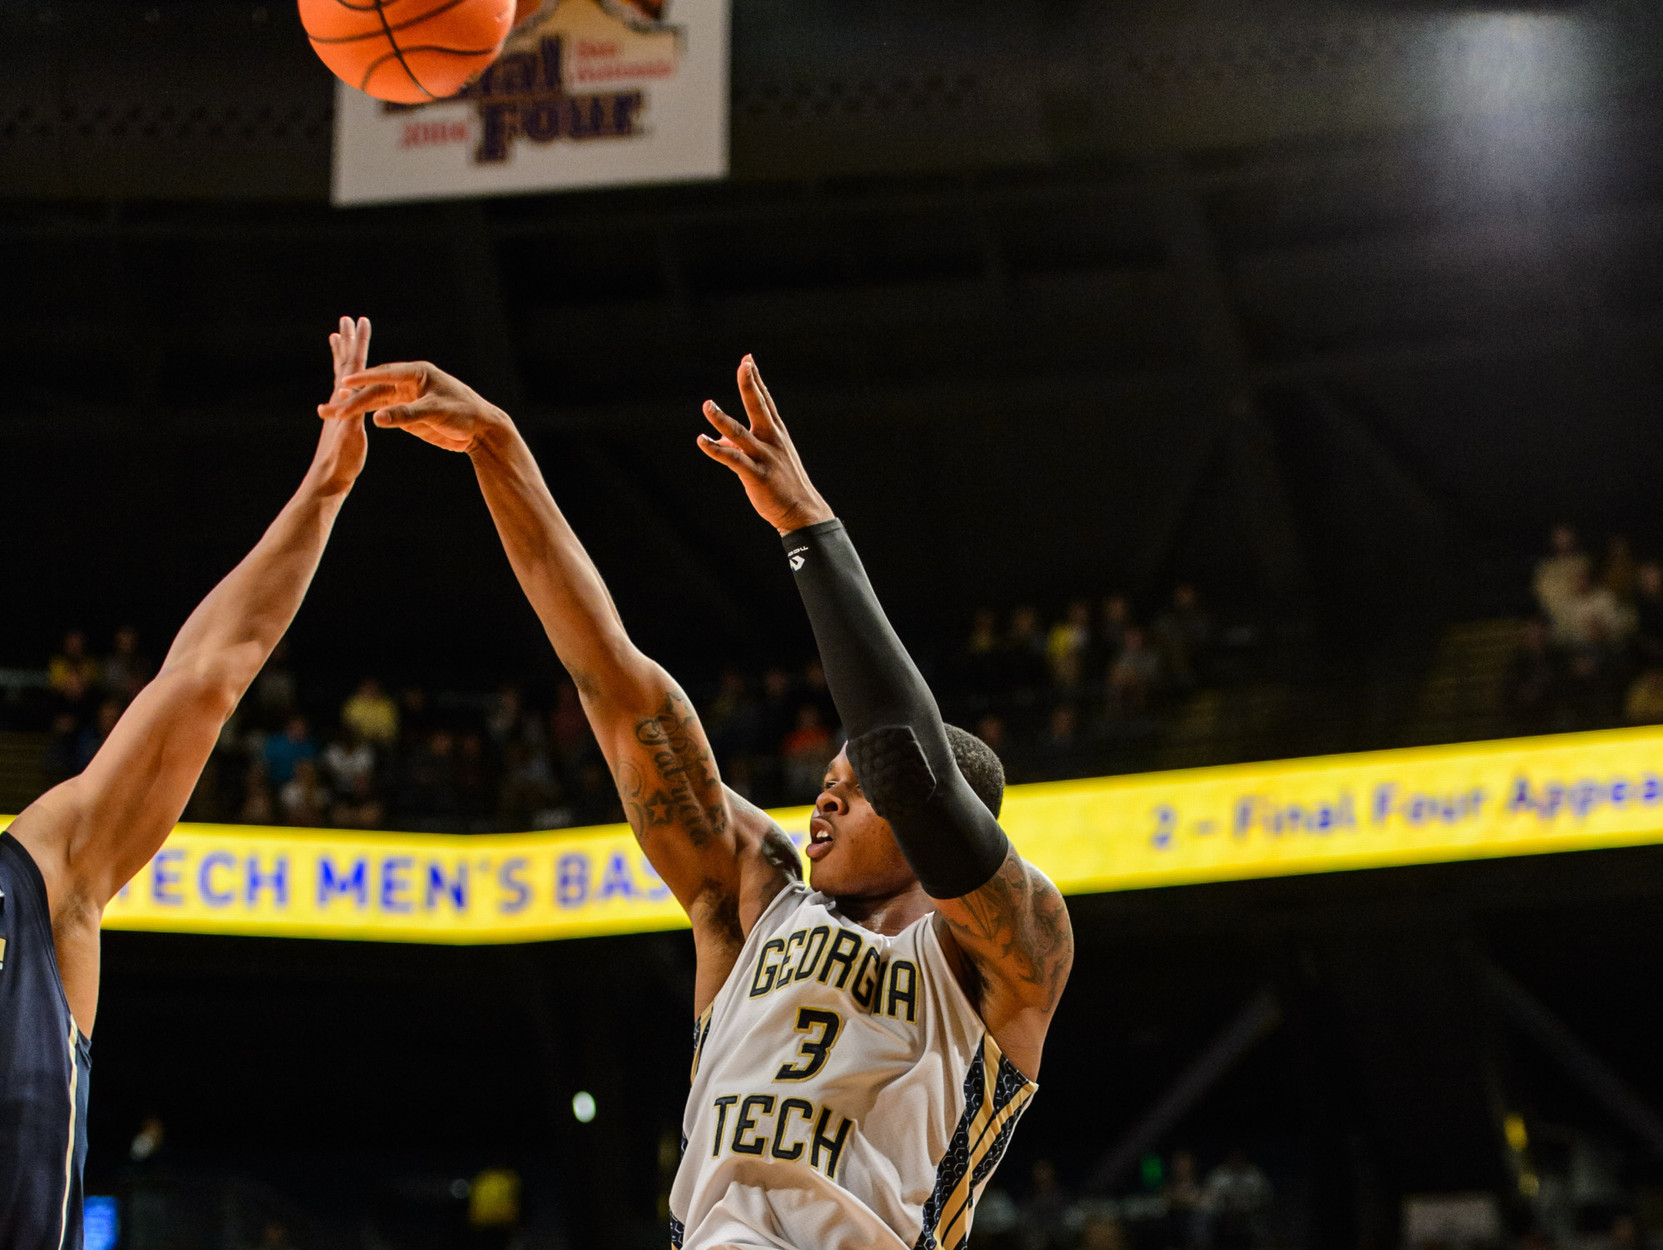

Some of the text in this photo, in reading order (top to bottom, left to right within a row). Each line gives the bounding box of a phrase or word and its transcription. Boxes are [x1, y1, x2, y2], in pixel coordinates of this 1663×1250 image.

[472, 90, 645, 164] Four
[1234, 794, 1357, 840] Final
[1372, 782, 1484, 827] Four
[117, 849, 292, 907] ECH
[317, 855, 533, 915] MEN'S
[749, 925, 920, 1025] GEORGIA
[771, 1006, 844, 1083] 3
[711, 1094, 859, 1181] TECH
